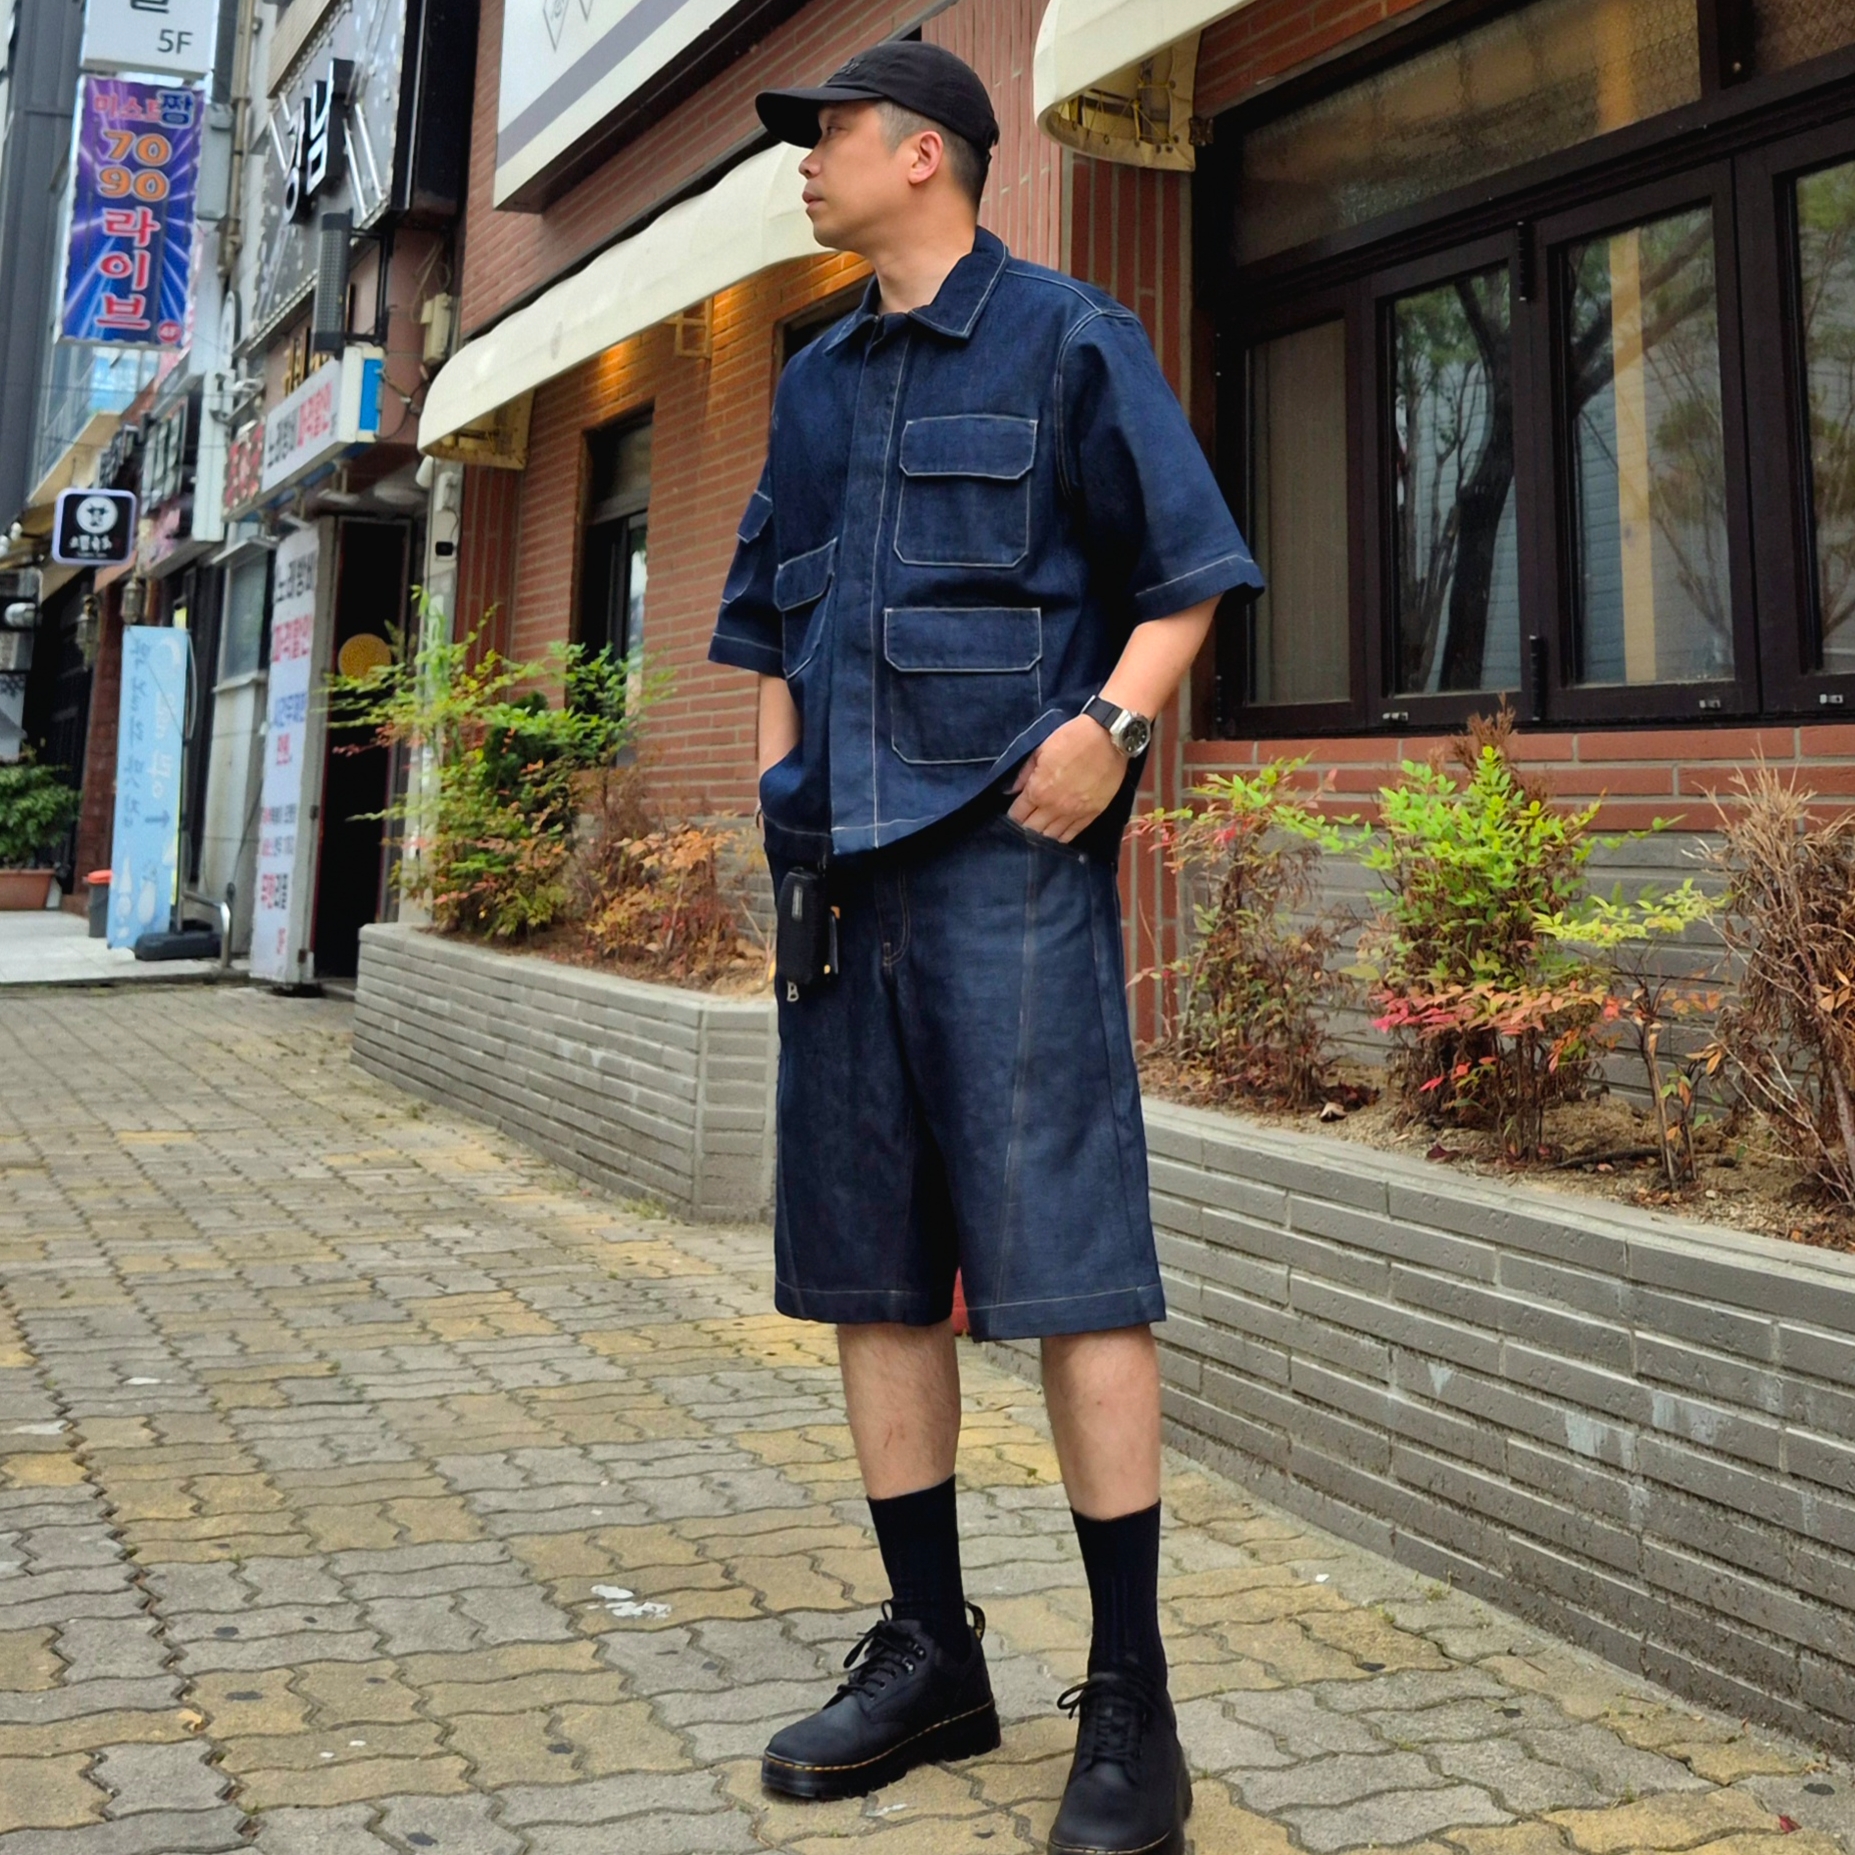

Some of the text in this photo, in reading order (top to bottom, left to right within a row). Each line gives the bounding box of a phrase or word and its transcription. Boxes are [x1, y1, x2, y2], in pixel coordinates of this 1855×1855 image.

[157, 28, 193, 54] 5F
[103, 130, 172, 167] 70
[98, 165, 170, 202] 90
[95, 206, 161, 331] 라이브
